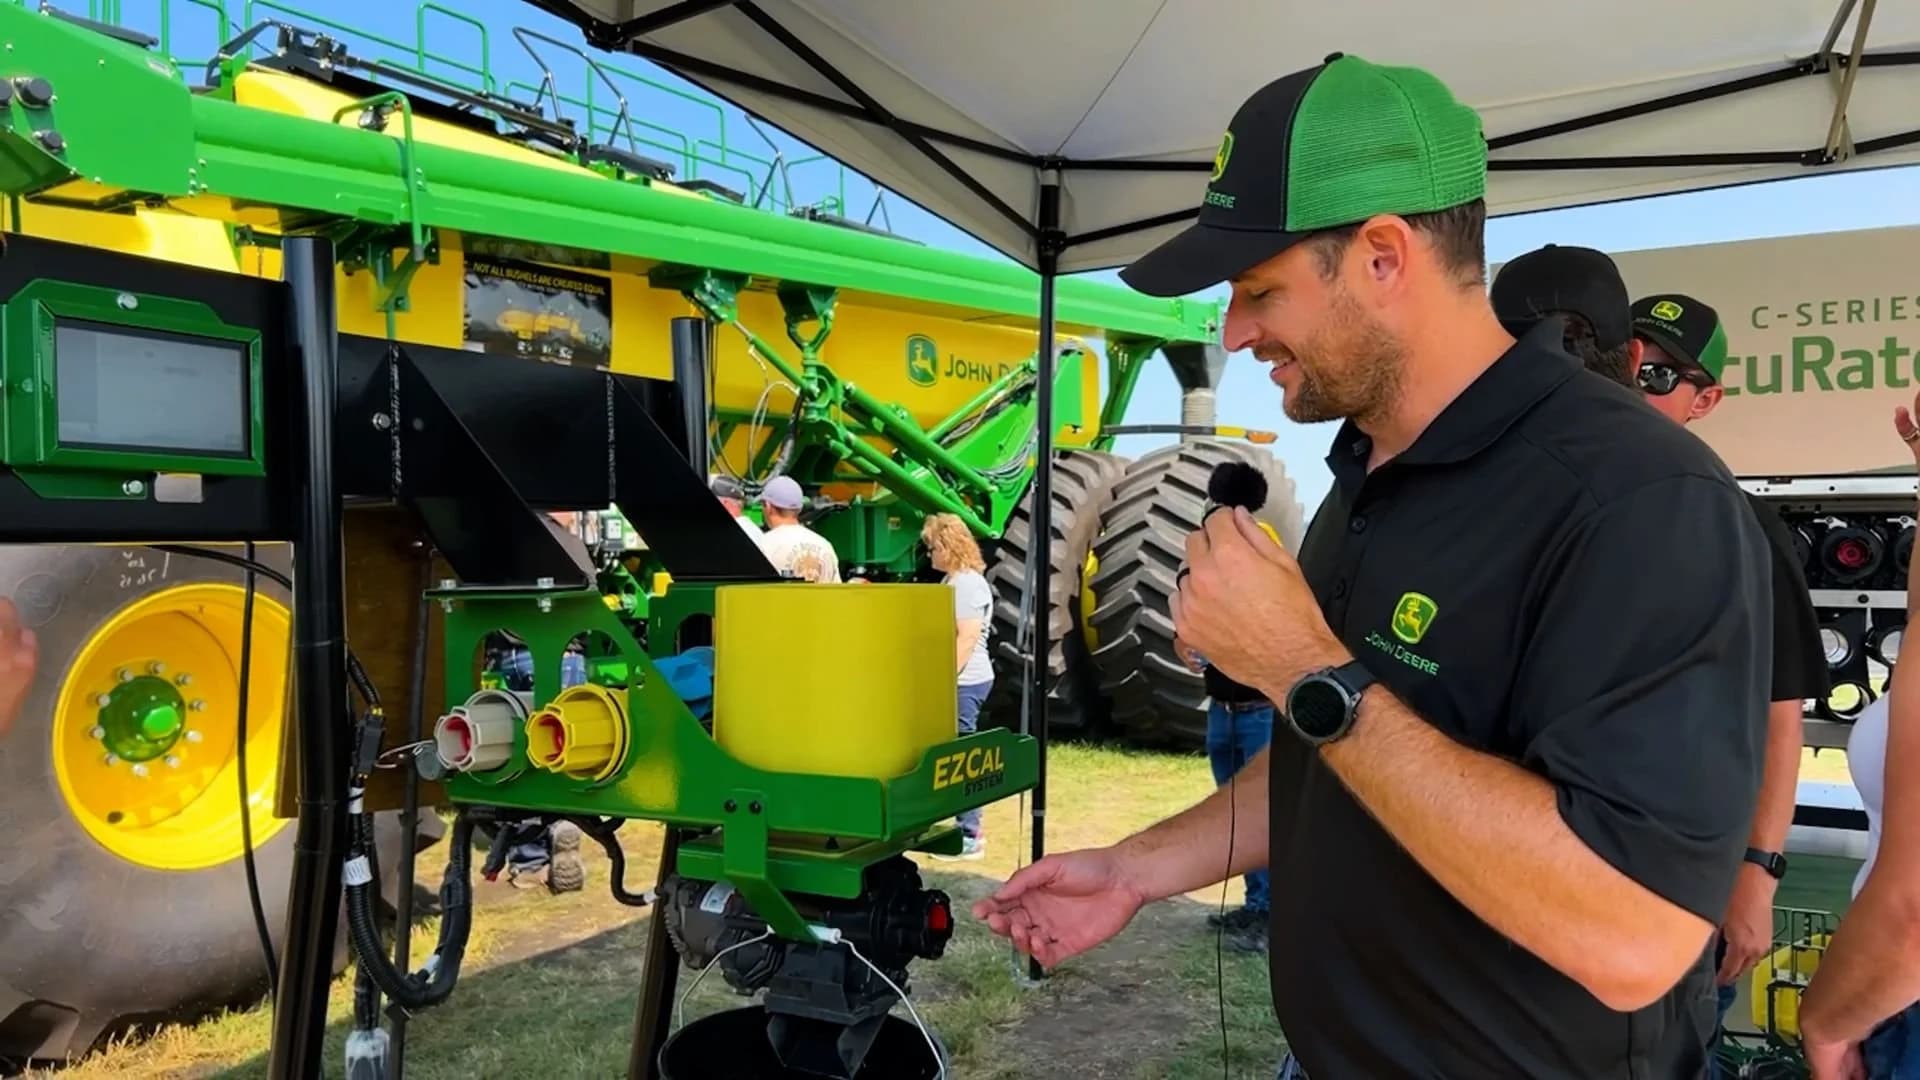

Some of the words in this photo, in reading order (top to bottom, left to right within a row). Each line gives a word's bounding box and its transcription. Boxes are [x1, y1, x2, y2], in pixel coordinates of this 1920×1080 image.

[473, 263, 490, 275] NOT
[490, 266, 505, 278] ALL
[505, 268, 538, 284] BUSHELS
[538, 274, 553, 286] ARE
[552, 277, 583, 292] CREATED
[583, 282, 606, 296] EQUAL
[1751, 295, 1920, 329] C-SERIE
[944, 353, 993, 384] JOHN
[1723, 335, 1920, 397] uRat
[1364, 630, 1396, 656] JOHN
[1395, 645, 1440, 676] DEERE
[934, 747, 1005, 791] EZCAL
[964, 772, 1005, 796] SYSTEM
